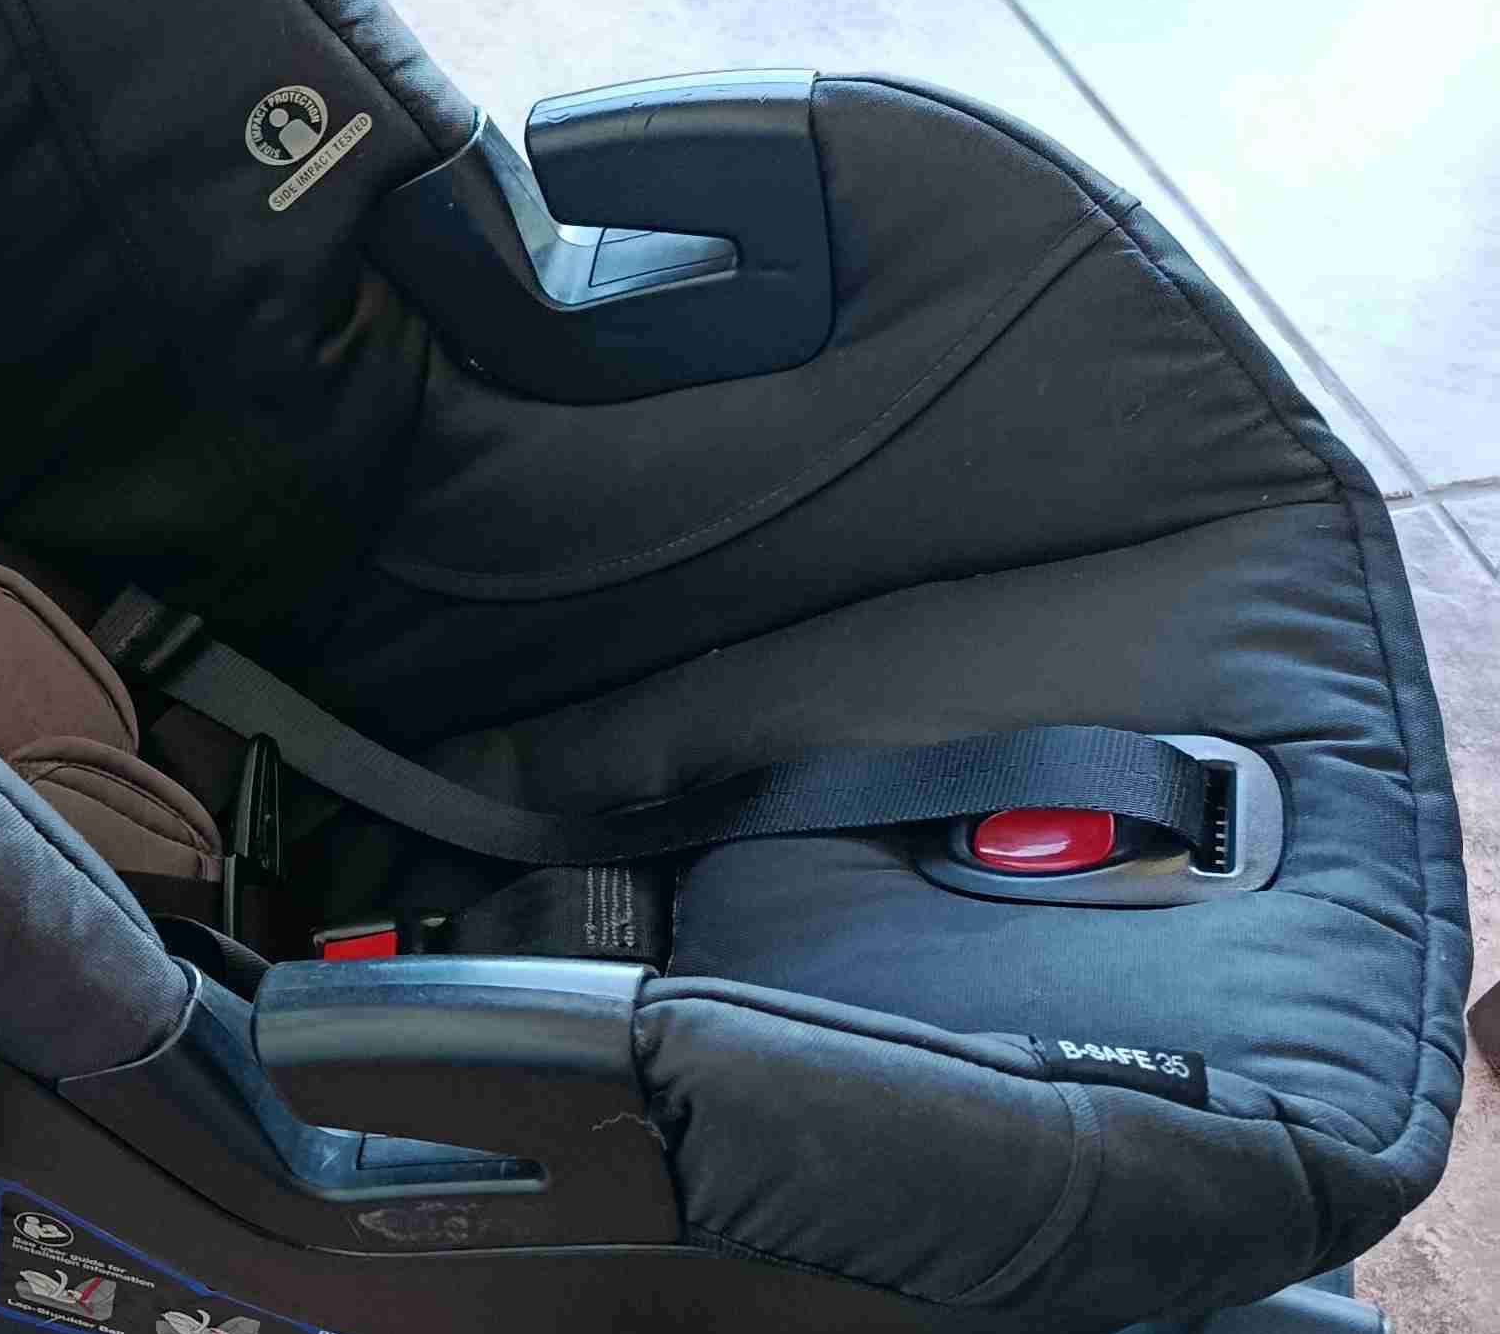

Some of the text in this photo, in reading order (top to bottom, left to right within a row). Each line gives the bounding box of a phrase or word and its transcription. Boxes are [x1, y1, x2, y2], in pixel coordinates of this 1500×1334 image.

[250, 90, 321, 161] SIDE IMPACT PROTECTION
[273, 116, 370, 208] SIDE IMPACT TESTED
[12, 1236, 40, 1250] See
[69, 1254, 106, 1269] guide
[81, 1261, 156, 1289] information
